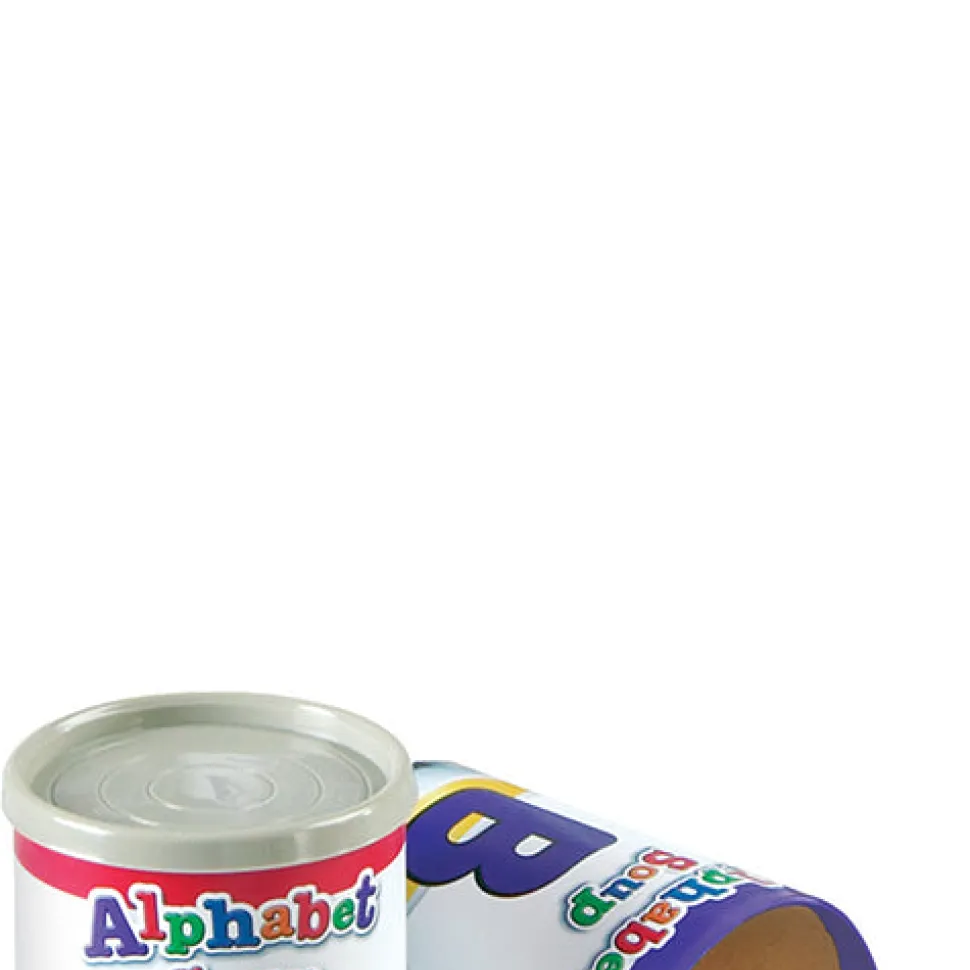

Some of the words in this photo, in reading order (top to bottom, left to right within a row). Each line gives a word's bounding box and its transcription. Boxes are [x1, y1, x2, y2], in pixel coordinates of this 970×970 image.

[406, 787, 618, 898] B
[86, 874, 378, 957] Alphabet
[570, 849, 698, 927] Soup
